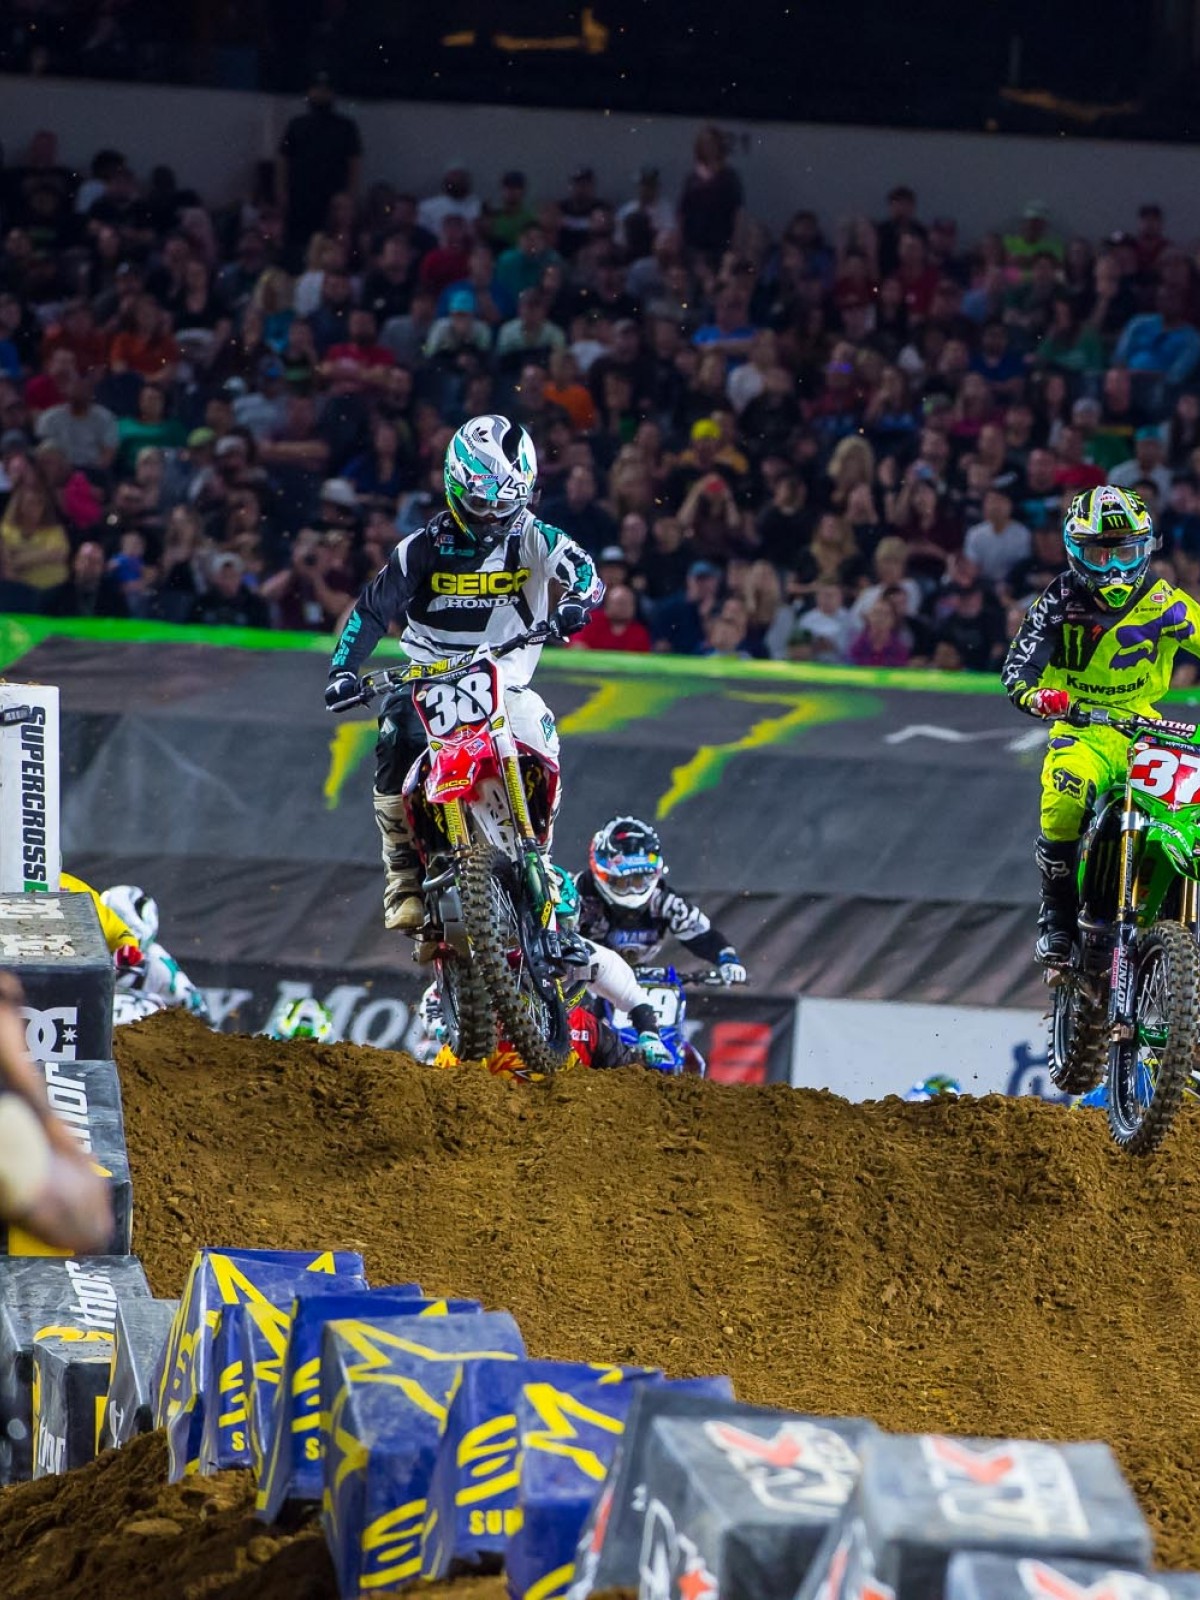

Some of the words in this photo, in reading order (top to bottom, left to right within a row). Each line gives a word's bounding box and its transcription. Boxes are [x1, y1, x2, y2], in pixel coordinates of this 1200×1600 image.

[431, 568, 531, 596] GEICO
[446, 596, 520, 609] HONDA
[424, 671, 493, 737] 38
[1066, 672, 1151, 697] Kawasaki
[1115, 945, 1129, 1015] DUNLOP
[44, 1062, 93, 1155] hor
